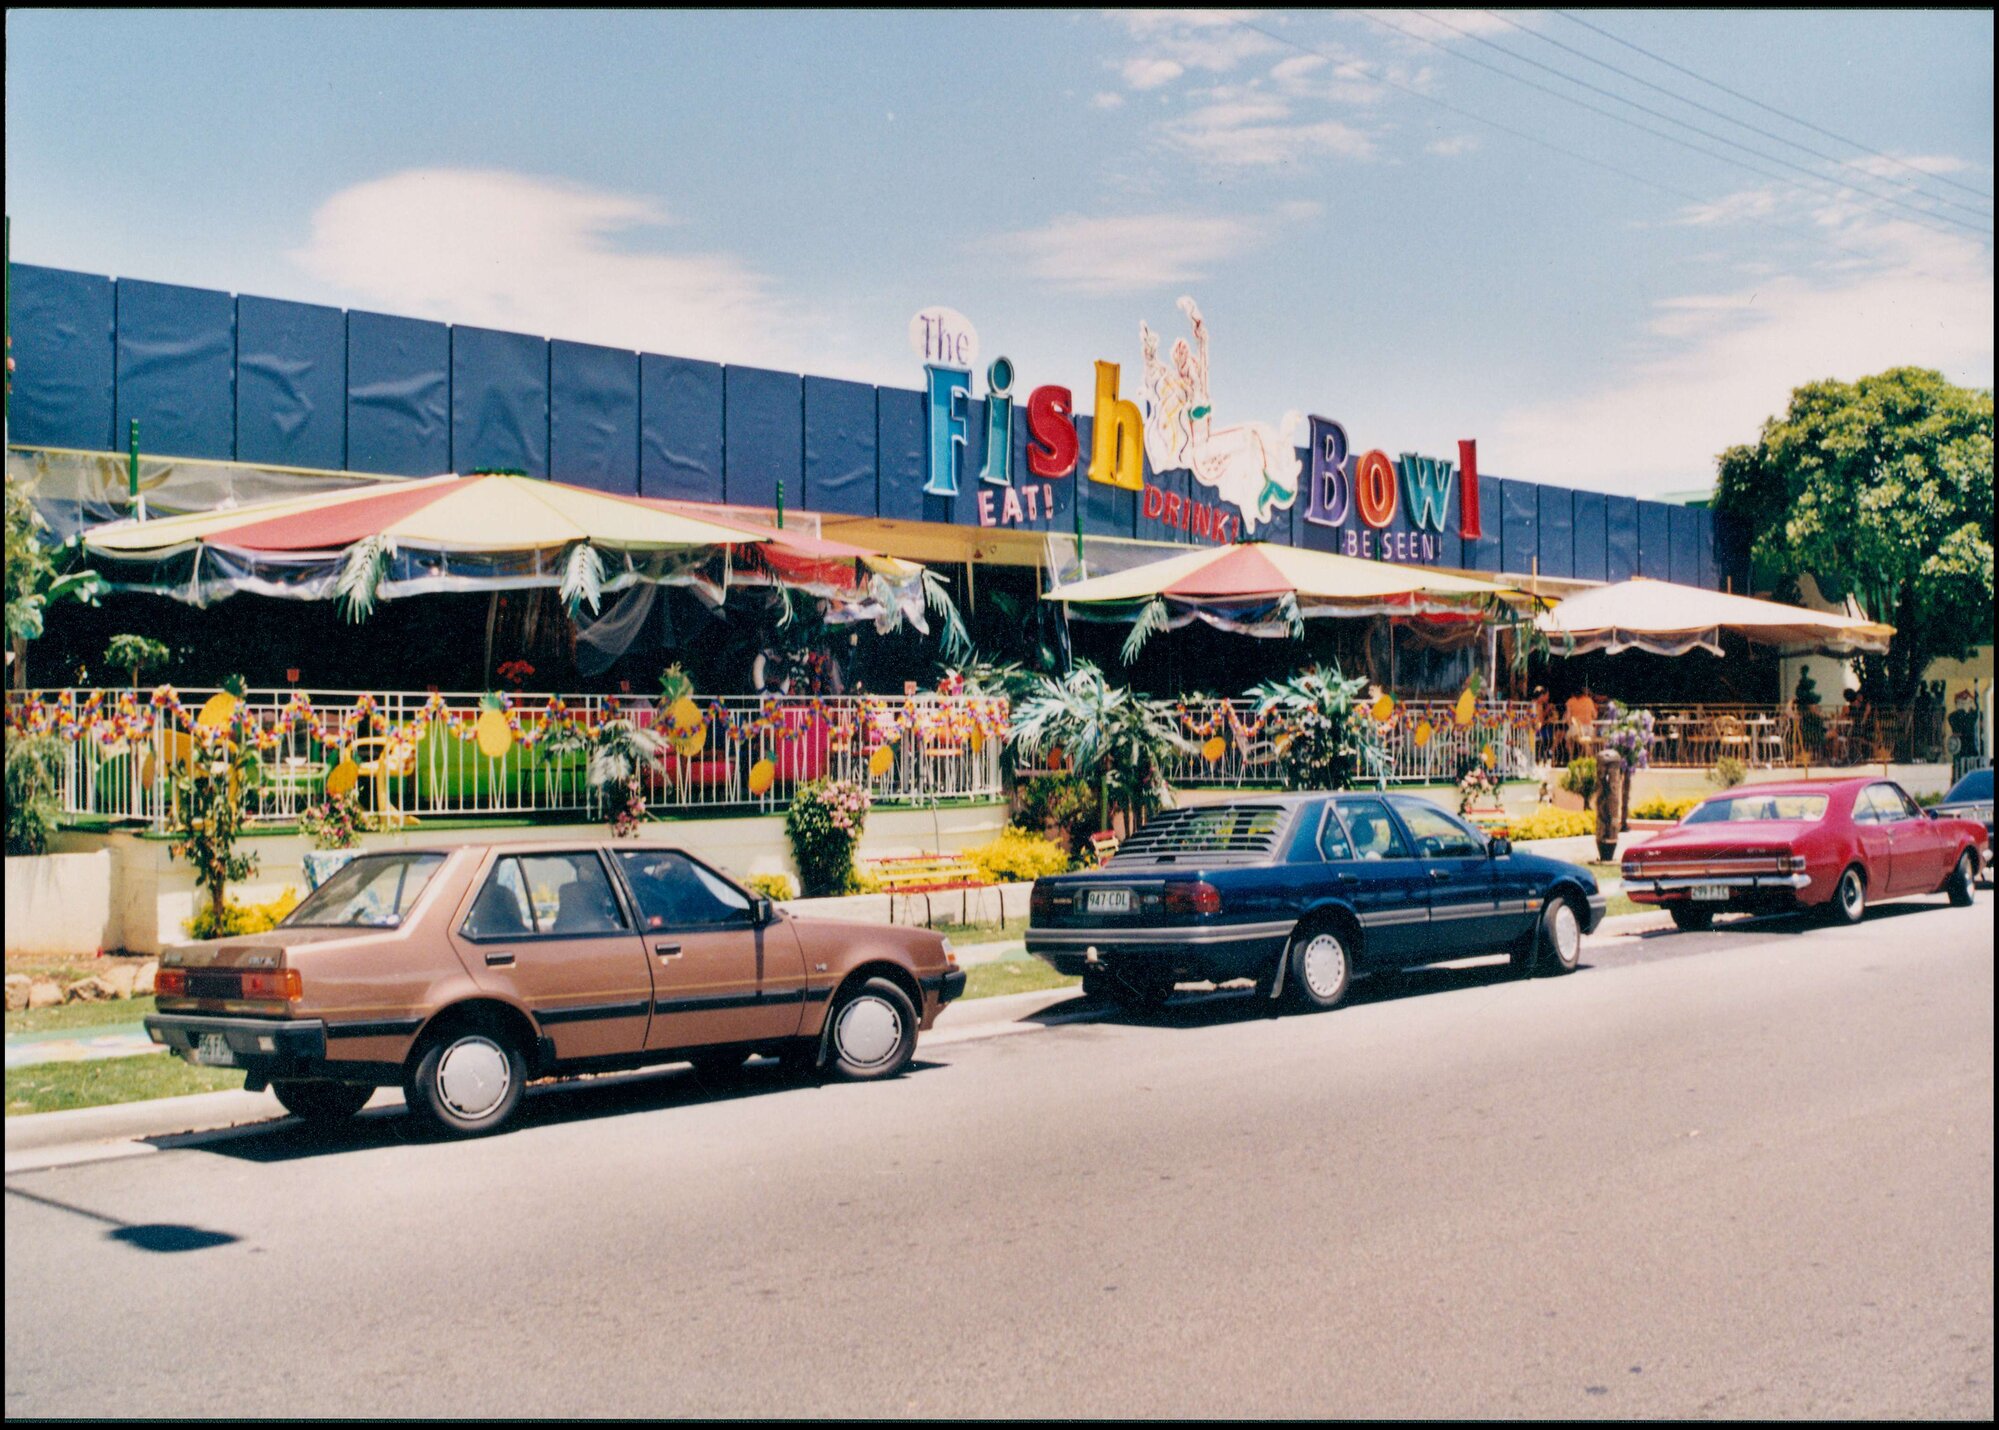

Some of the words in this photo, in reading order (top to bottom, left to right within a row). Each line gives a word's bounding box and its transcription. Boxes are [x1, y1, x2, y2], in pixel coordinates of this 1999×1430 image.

[920, 314, 970, 365] The
[923, 356, 1145, 497] Fish
[977, 483, 1054, 528] EAT!
[1143, 483, 1240, 545] DRINK!
[1347, 529, 1372, 558] BE
[1382, 531, 1442, 561] SEEN!
[1090, 892, 1106, 906] 947
[1108, 891, 1127, 906] CDL
